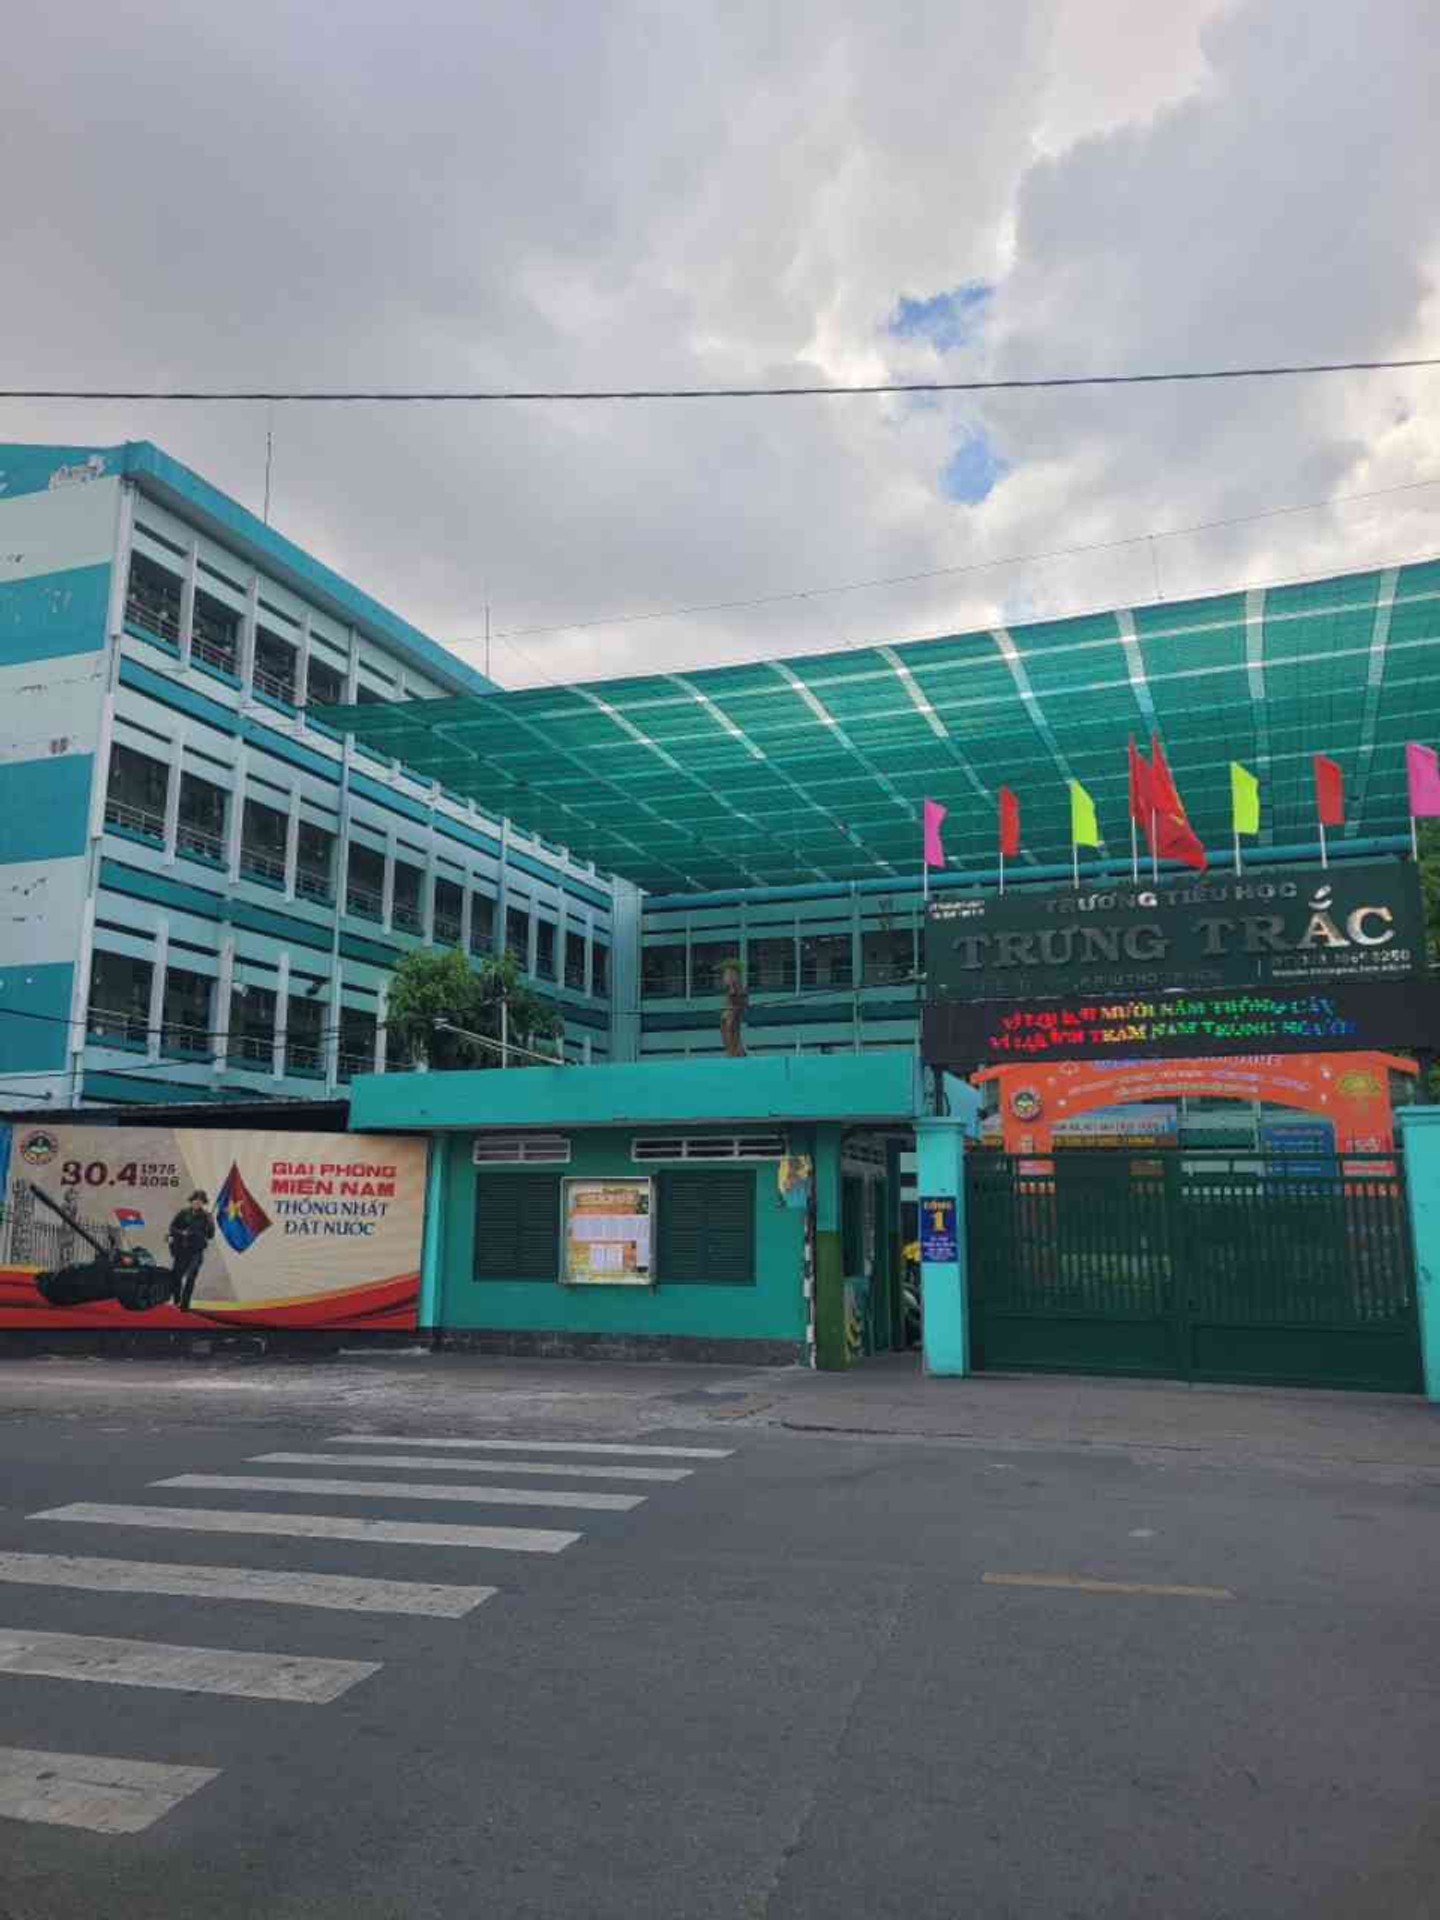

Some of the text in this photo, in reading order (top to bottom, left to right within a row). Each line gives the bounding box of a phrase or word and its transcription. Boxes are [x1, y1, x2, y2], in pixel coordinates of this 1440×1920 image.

[1192, 885, 1395, 954] TRẮC
[60, 1160, 138, 1187] 30.4
[142, 1163, 177, 1176] 1975
[341, 1181, 395, 1197] NAM
[932, 1211, 949, 1232] 1
